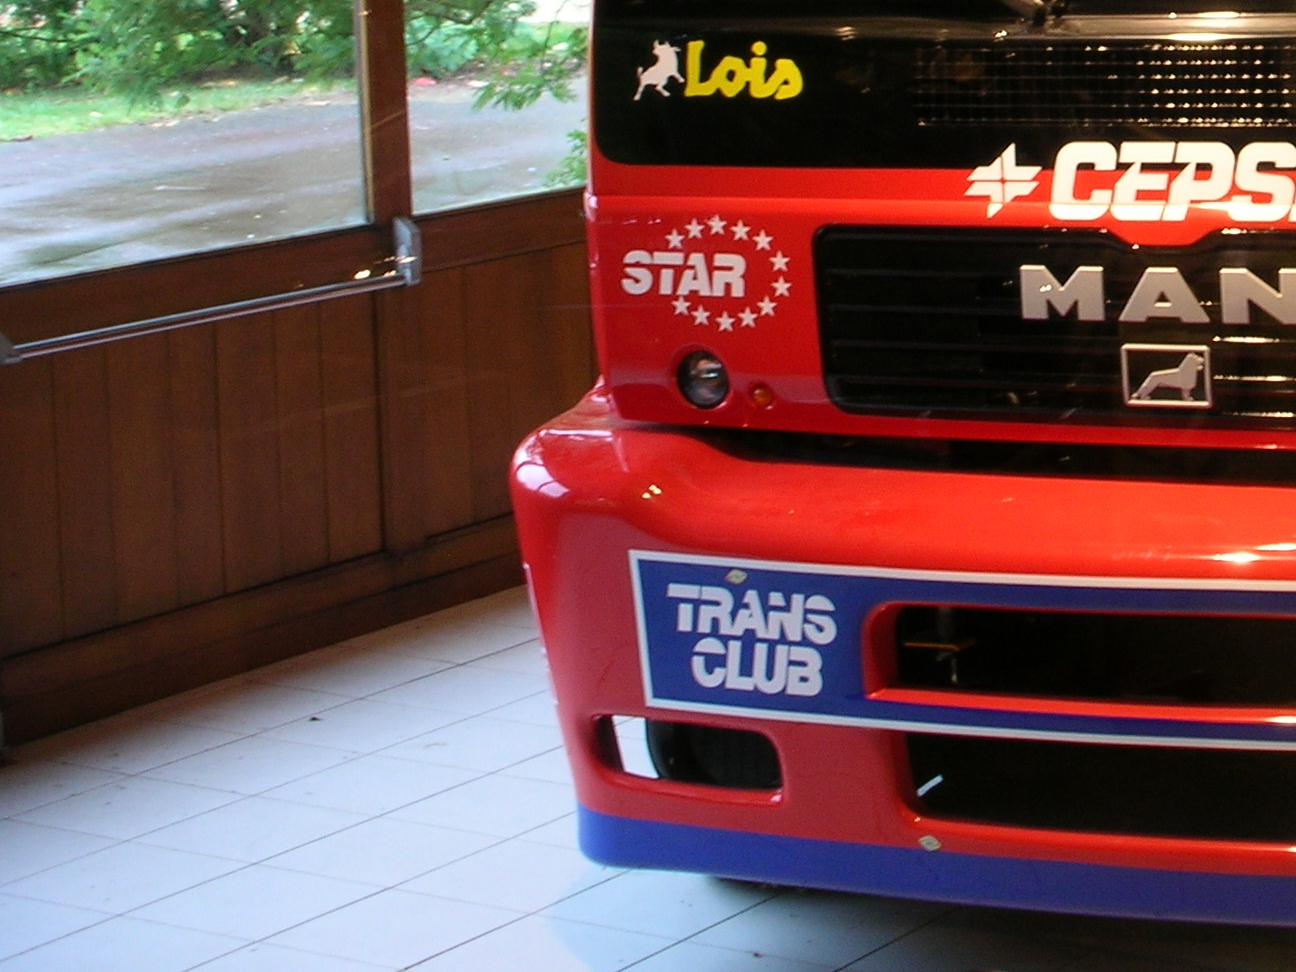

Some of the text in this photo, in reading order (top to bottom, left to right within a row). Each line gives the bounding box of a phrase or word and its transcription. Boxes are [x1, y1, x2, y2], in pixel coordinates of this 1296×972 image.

[684, 40, 803, 100] Lois
[620, 250, 747, 299] STAR
[666, 583, 838, 645] TRANS
[692, 636, 823, 697] CLUB
